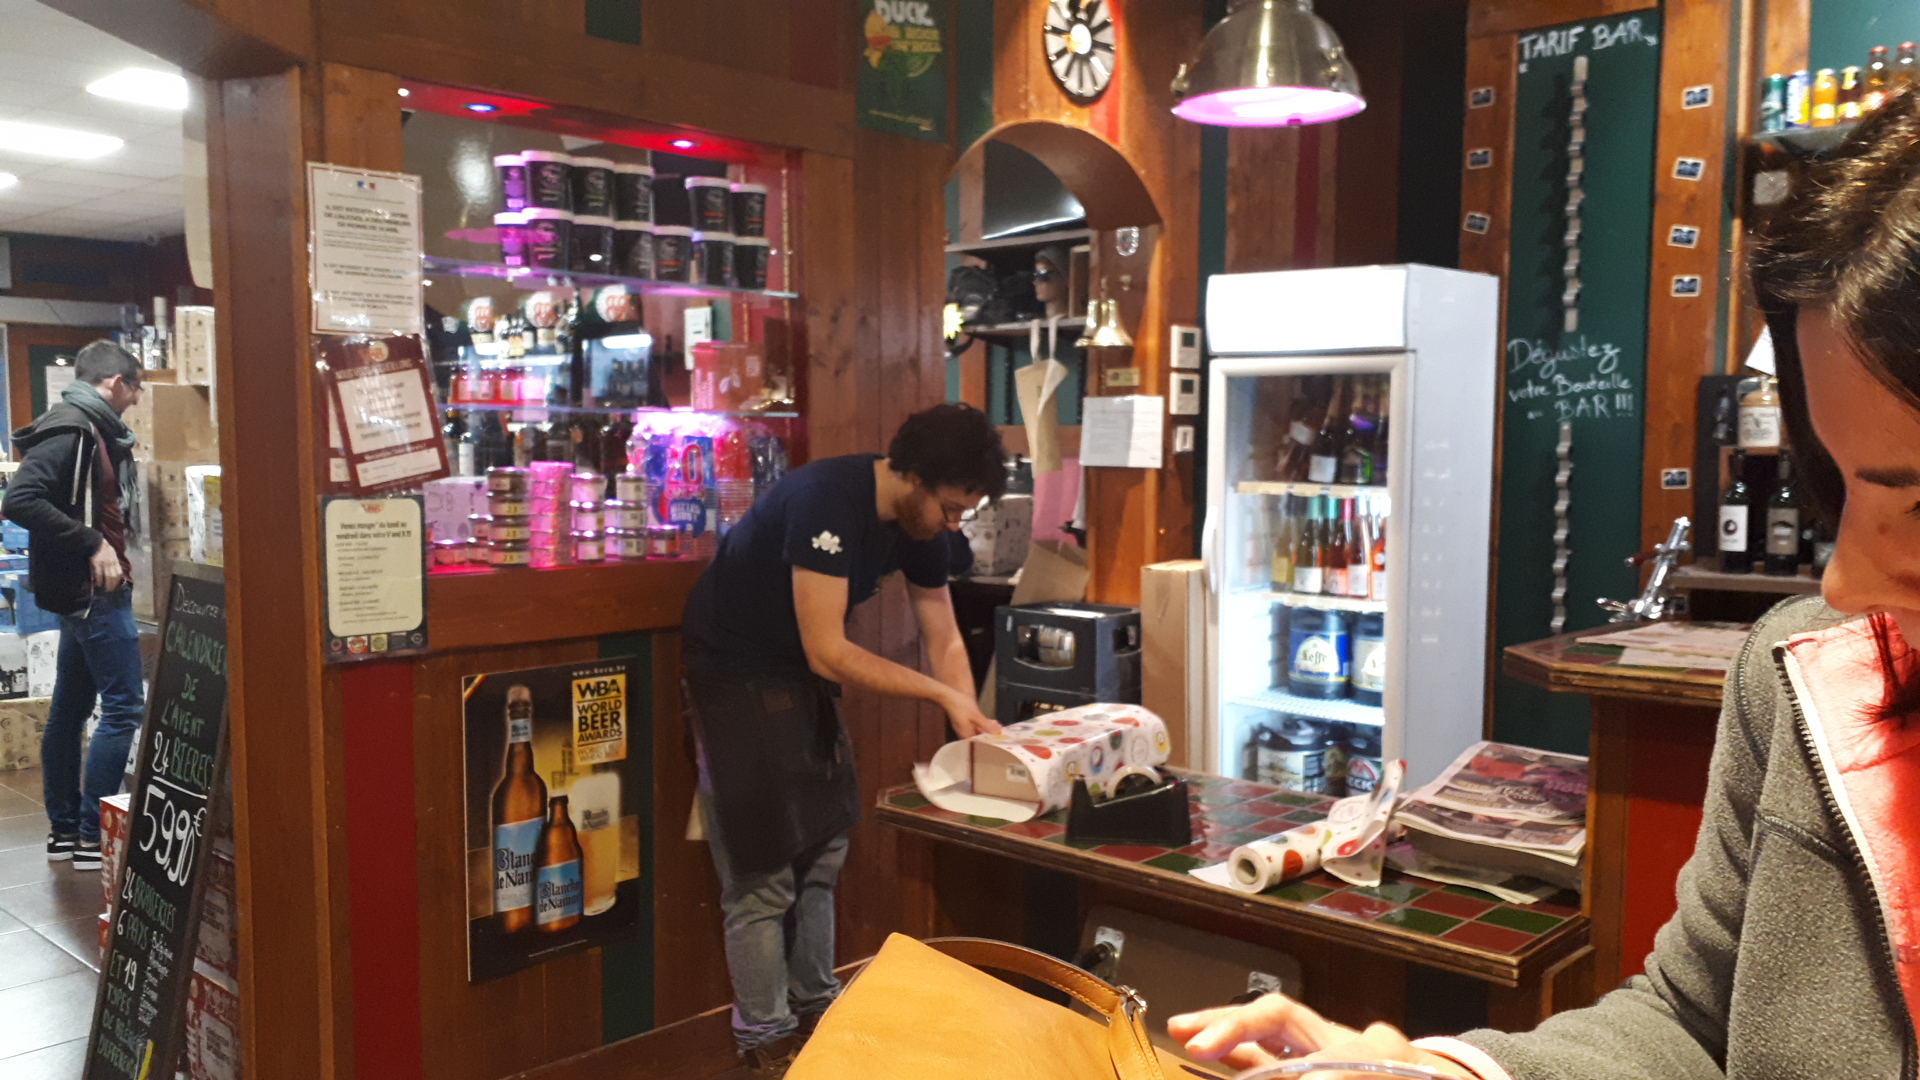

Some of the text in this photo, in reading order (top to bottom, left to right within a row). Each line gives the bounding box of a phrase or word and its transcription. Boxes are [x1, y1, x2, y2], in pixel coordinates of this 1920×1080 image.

[1518, 18, 1643, 61] TARIF BAR
[1508, 334, 1621, 379] Dégustez
[1509, 380, 1551, 402] votre
[1555, 394, 1611, 422] BAR
[181, 672, 199, 702] DE
[577, 679, 621, 699] WBA
[161, 698, 205, 739] L'AVENT
[577, 699, 622, 715] WORLD
[578, 711, 621, 733] BEER
[577, 728, 622, 743] AWARDS
[152, 730, 170, 776] 24
[122, 866, 136, 904] 24
[117, 909, 149, 950] 6 PAYS
[108, 949, 126, 979] ET
[124, 957, 137, 991] 19
[107, 982, 133, 1016] TYPES
